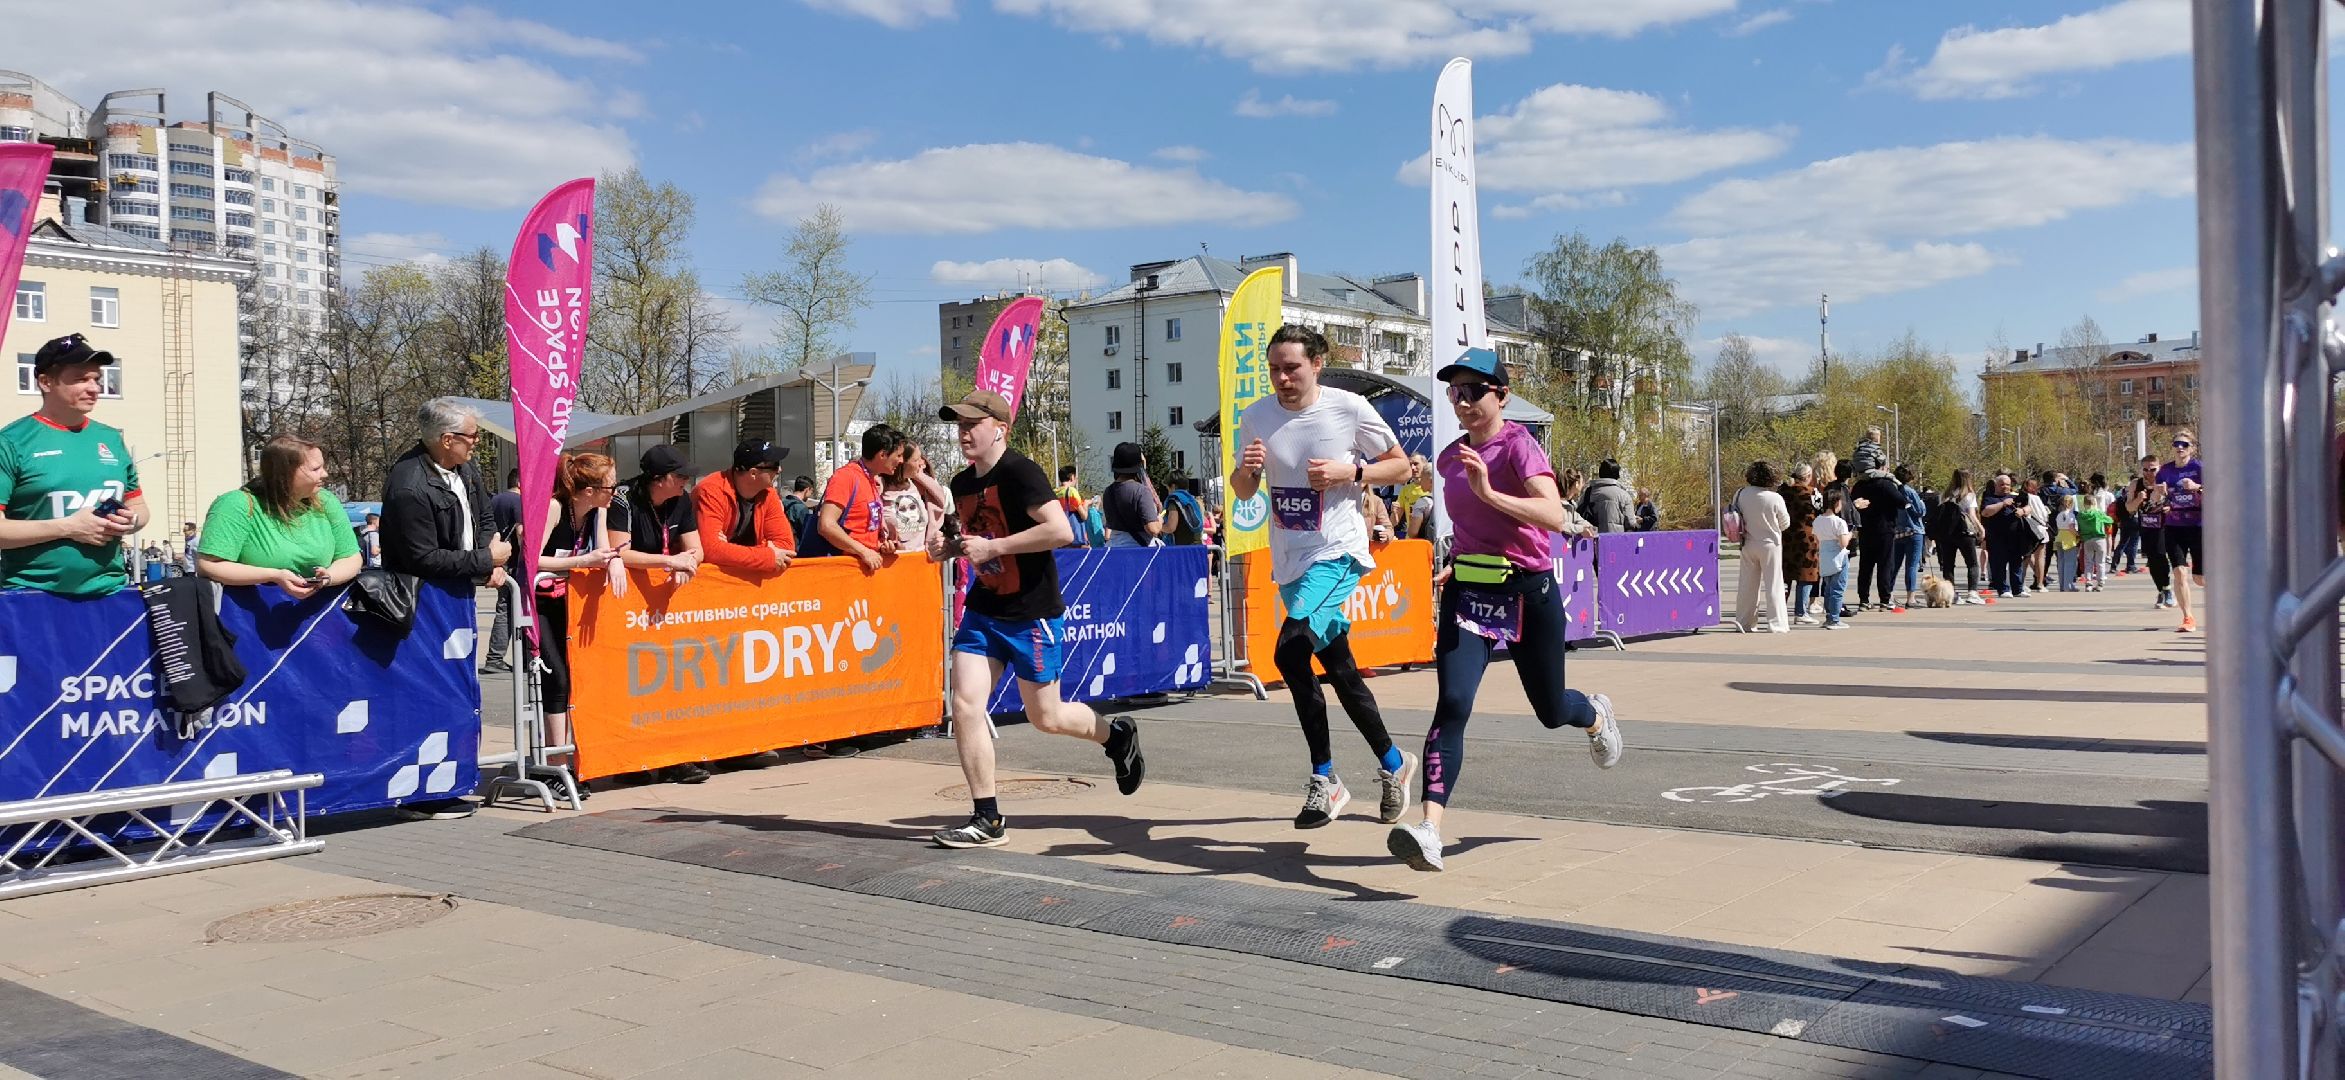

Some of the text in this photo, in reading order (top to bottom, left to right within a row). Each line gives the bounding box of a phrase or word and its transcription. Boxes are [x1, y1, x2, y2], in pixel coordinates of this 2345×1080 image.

[537, 288, 568, 389] SPACE
[1257, 321, 1270, 398] ДОРОВЬЯ
[1233, 322, 1255, 450] ТЕКИ
[1398, 415, 1433, 427] SPACE
[1400, 427, 1433, 439] MARA
[1276, 497, 1312, 512] 1456
[625, 598, 821, 631] Эффективные средства
[1063, 603, 1091, 621] ACE
[1470, 601, 1507, 620] 1174
[1061, 621, 1126, 643] ARATHON
[61, 701, 266, 739] MARAON
